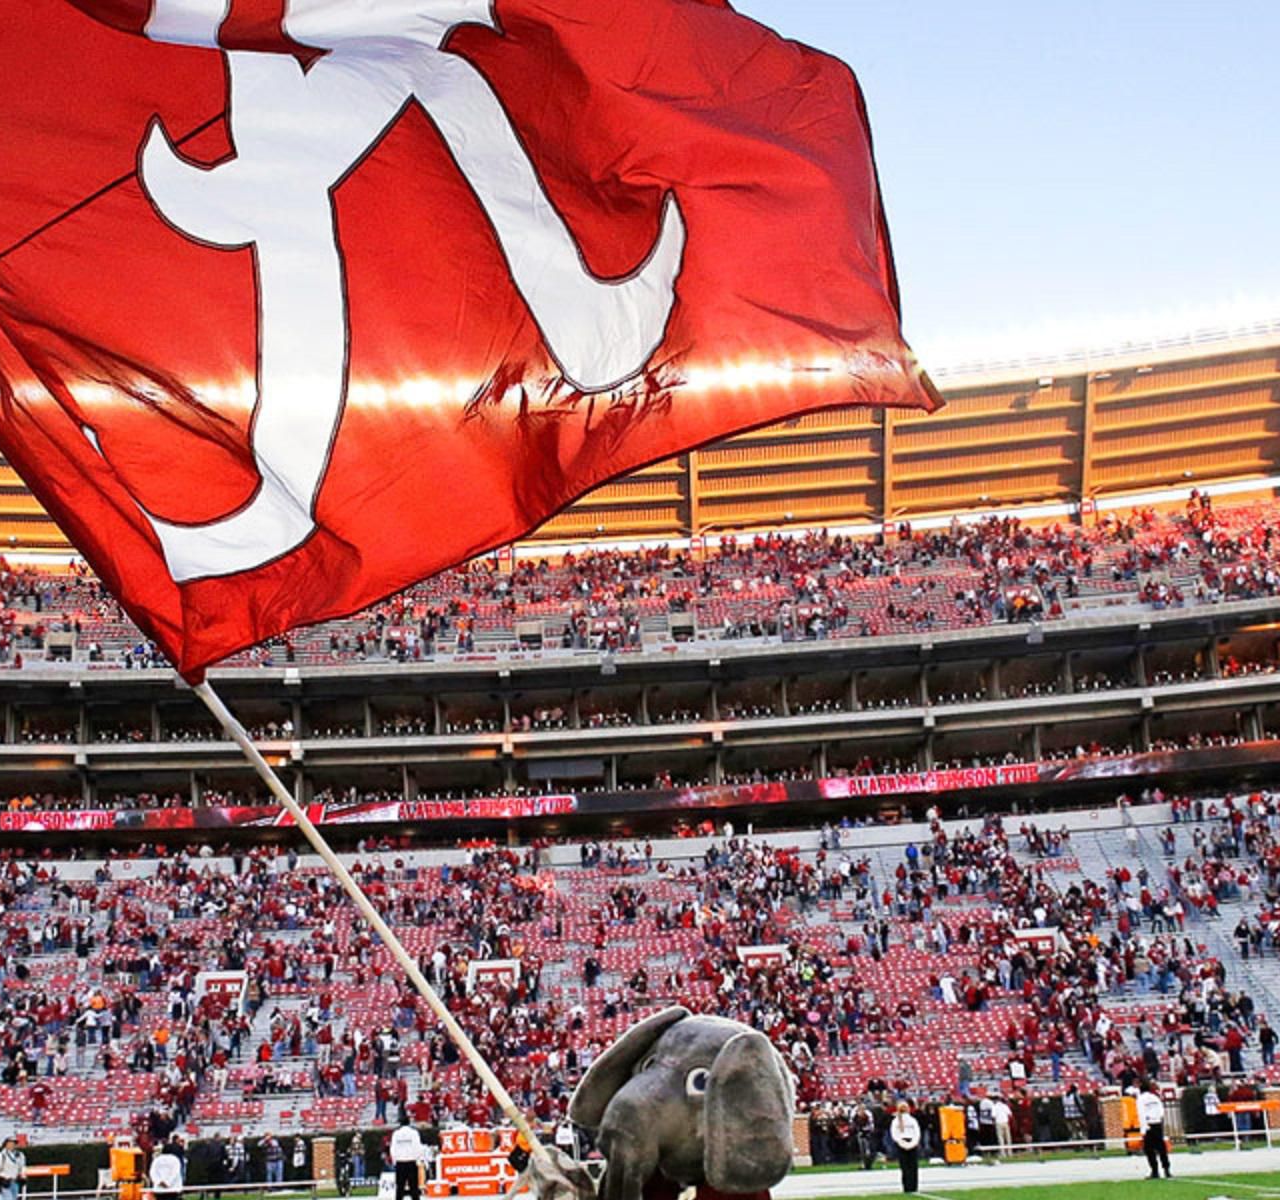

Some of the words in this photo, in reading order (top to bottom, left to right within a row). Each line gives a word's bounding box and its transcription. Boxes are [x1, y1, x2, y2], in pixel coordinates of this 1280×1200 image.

[848, 775, 919, 795] ALABAMA
[922, 769, 996, 791] CRIMSON
[1001, 765, 1041, 784] TIDE
[0, 811, 75, 831] CRIMSON
